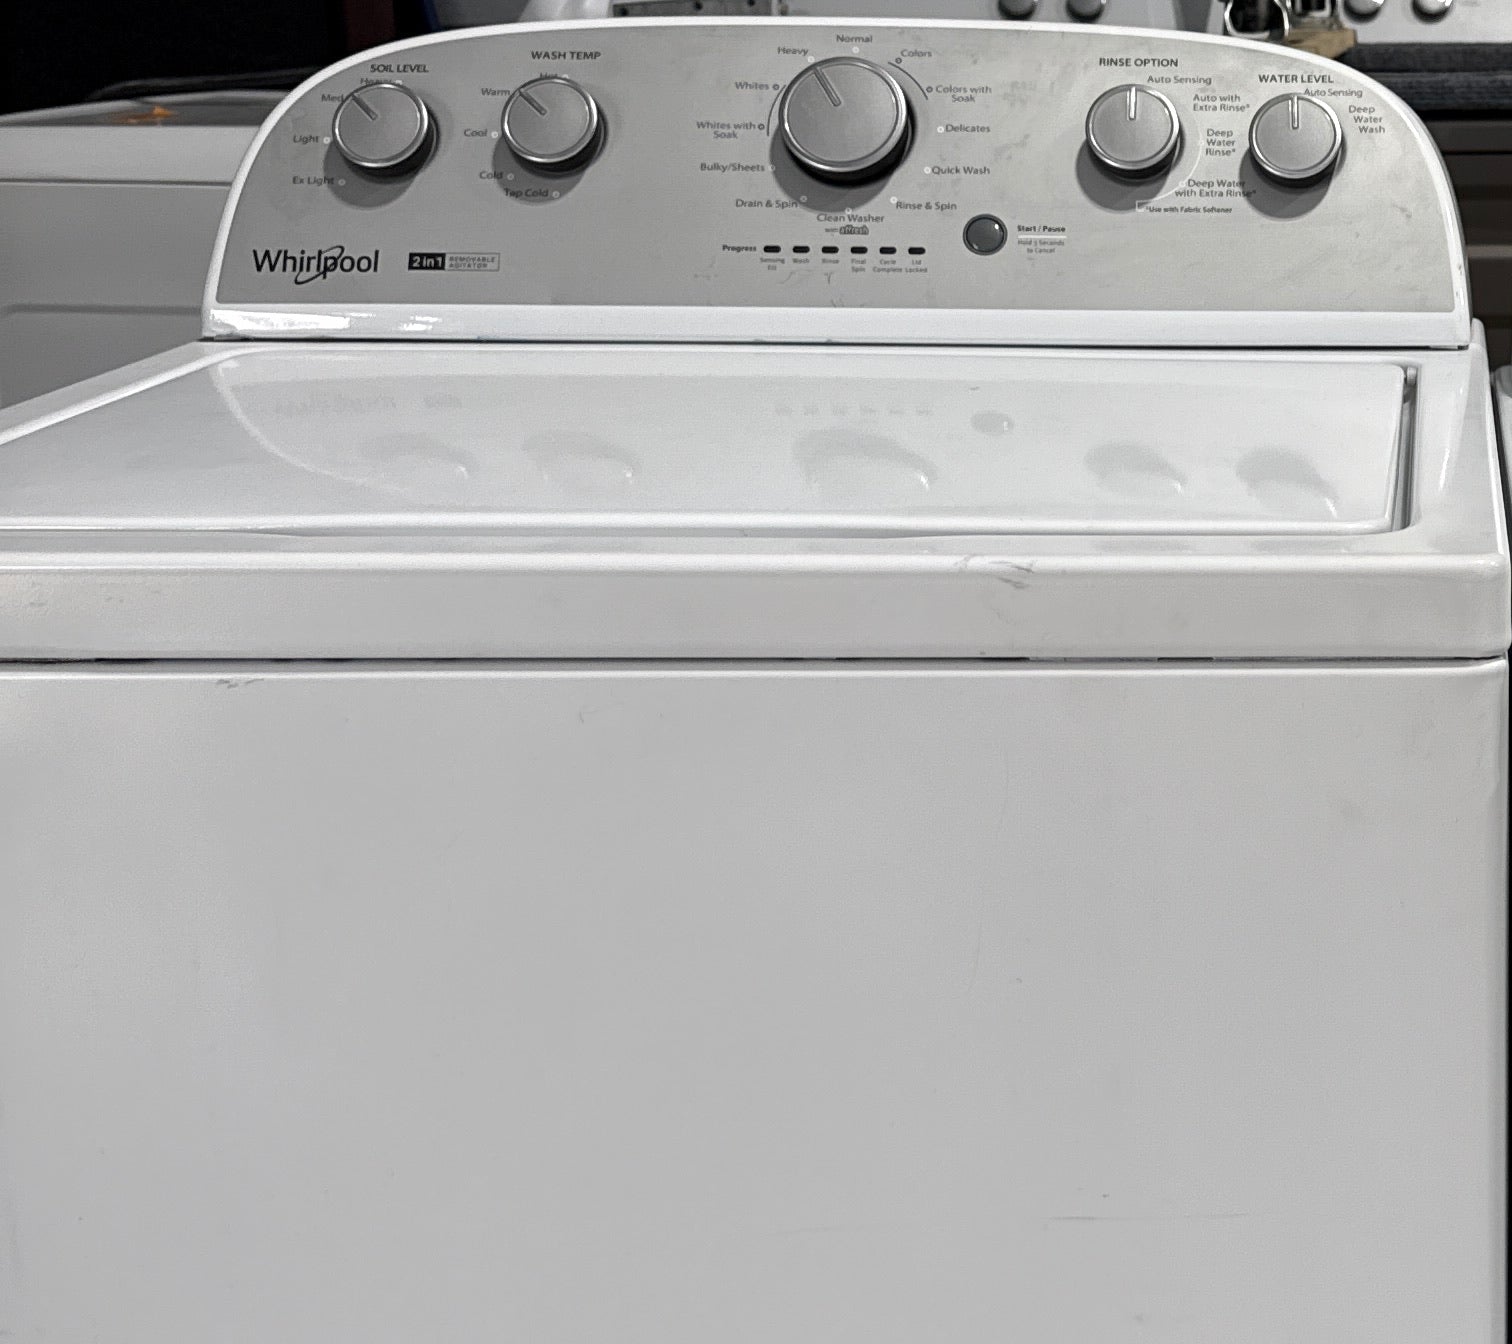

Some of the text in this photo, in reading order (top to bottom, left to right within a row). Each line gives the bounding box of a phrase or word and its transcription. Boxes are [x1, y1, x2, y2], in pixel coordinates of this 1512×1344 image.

[836, 34, 873, 44] Normal
[531, 51, 602, 60] WASH TEMP
[777, 46, 810, 57] Heavy
[900, 49, 932, 58] Colors
[1099, 58, 1179, 68] RINSE OPTION
[370, 64, 430, 74] SOIL LEVEL
[1147, 75, 1212, 86] Auto Sensing
[1258, 74, 1334, 84] WATER LEVEL
[735, 81, 770, 91] Whites
[935, 85, 992, 94] Colors with
[481, 88, 510, 96] Warm
[1304, 88, 1362, 99] Auto Sensing
[321, 94, 344, 103] Med
[951, 94, 976, 103] Soak
[1193, 93, 1241, 102] Auto with
[1193, 103, 1219, 112] Extra
[1348, 105, 1376, 116] Deep
[1353, 115, 1383, 124] Water
[696, 121, 757, 130] Whites with
[945, 124, 991, 134] Delicates
[1358, 125, 1386, 134] Wash
[464, 129, 488, 138] Cool
[713, 130, 738, 140] Soak
[1206, 129, 1234, 139] Deep
[293, 135, 320, 146] Light
[1206, 138, 1235, 148] Water
[700, 163, 766, 174] Bulky/Sheets
[932, 166, 990, 176] Quick Wash
[479, 171, 504, 180] Cold
[292, 176, 334, 188] Ex Light
[1187, 179, 1246, 190] Deep Water
[504, 188, 549, 200] Tap Cold
[1175, 189, 1198, 198] with
[1200, 189, 1224, 198] Extra
[735, 199, 798, 210] Drain & Spin
[896, 201, 958, 213] Rinse & Spin
[817, 213, 884, 223] Clean Washer
[722, 245, 757, 254] Progress
[252, 248, 380, 282] Whirlpool
